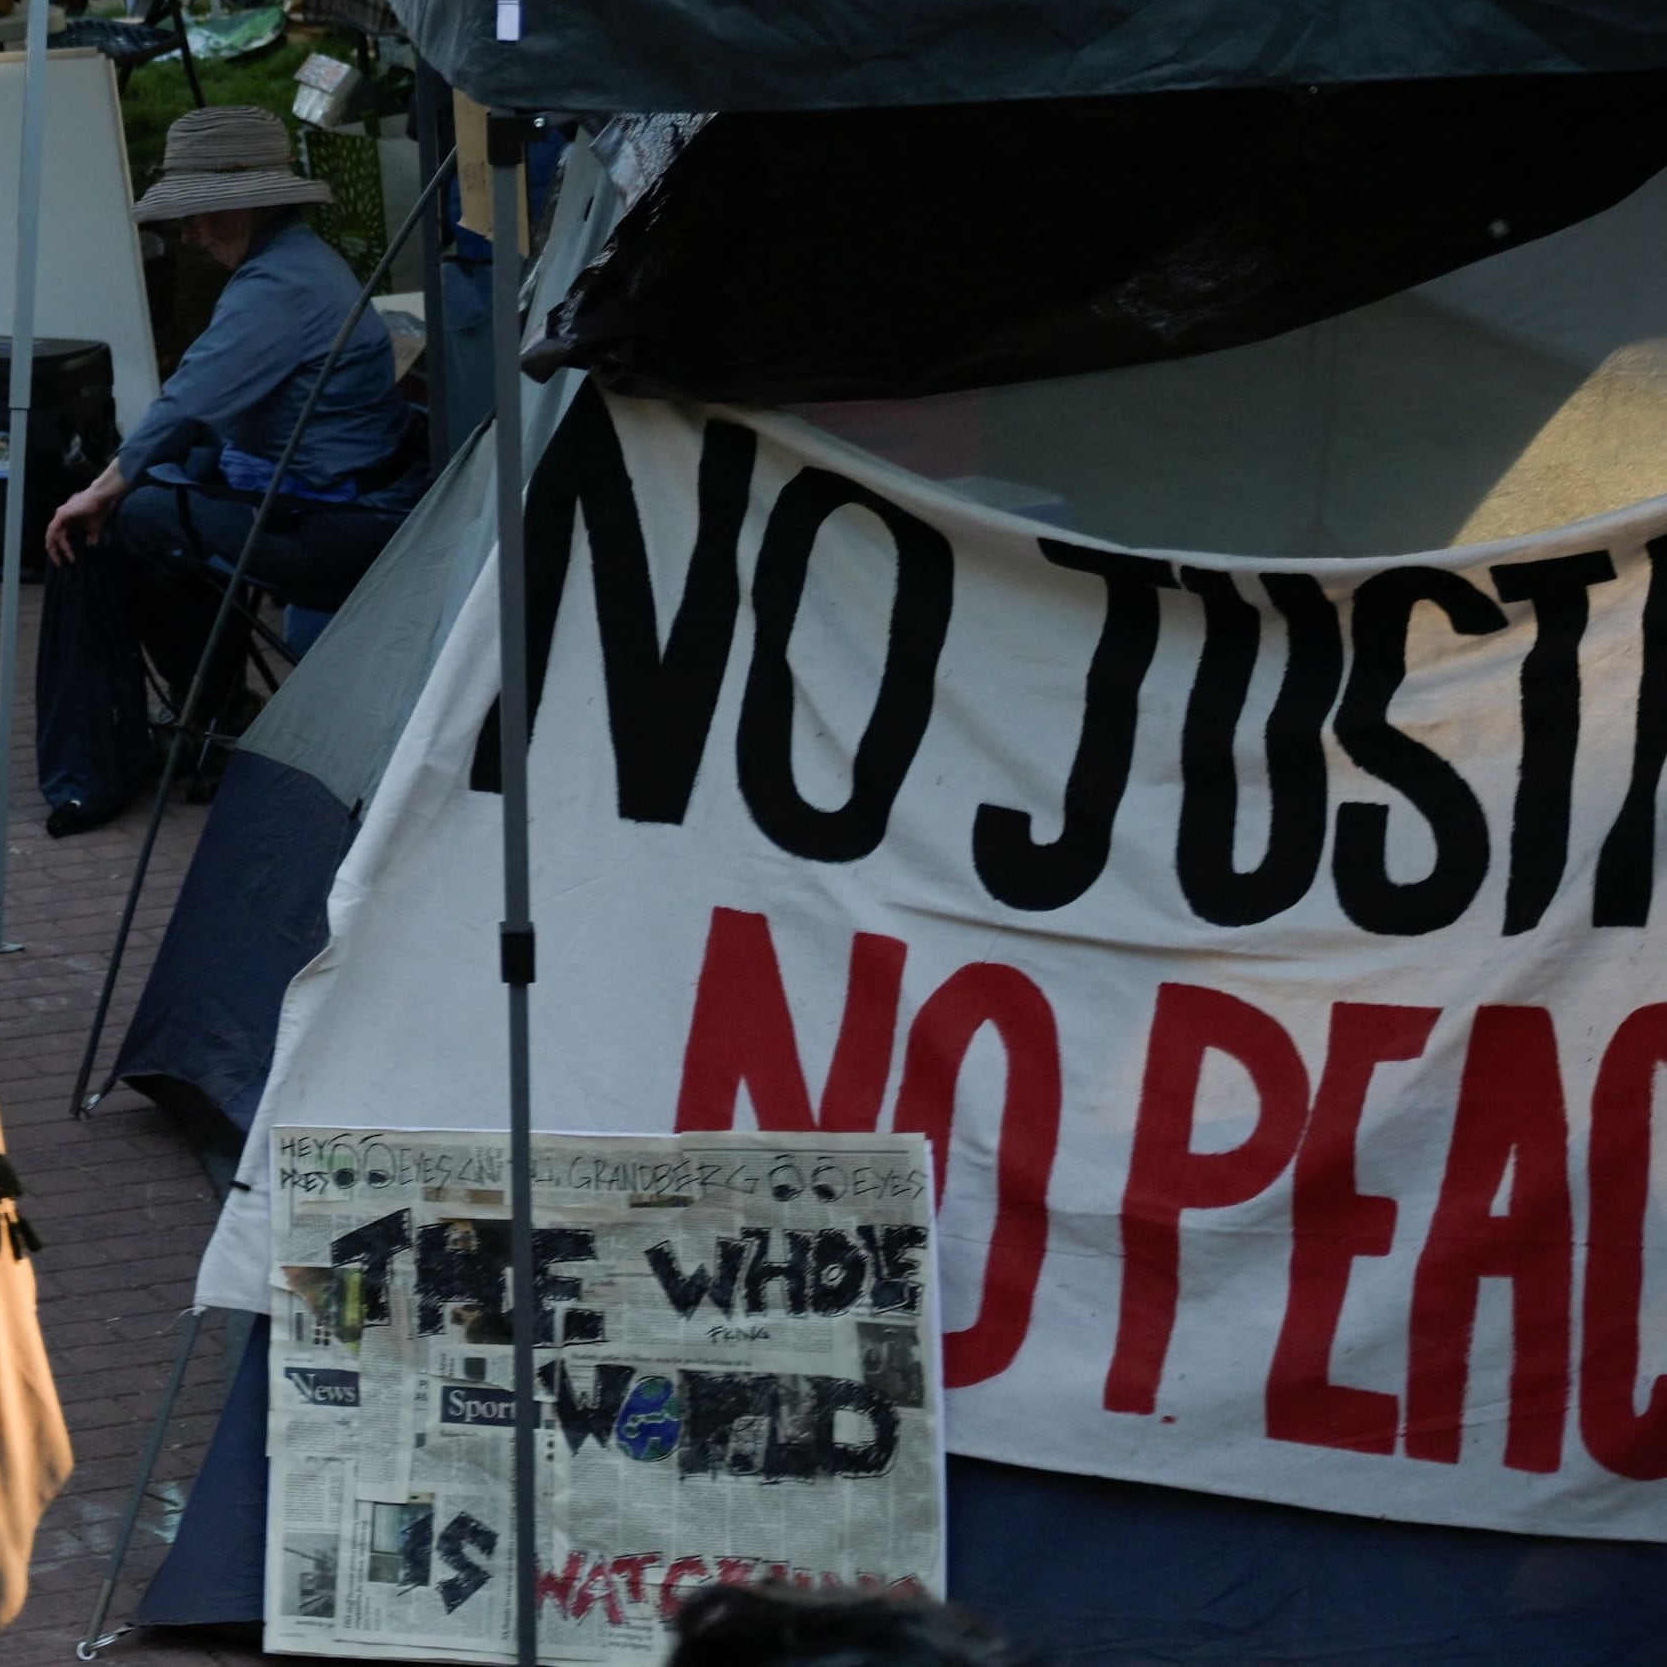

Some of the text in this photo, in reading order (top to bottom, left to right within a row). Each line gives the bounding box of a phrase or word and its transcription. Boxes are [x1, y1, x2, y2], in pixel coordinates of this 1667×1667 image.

[469, 373, 954, 864] NO
[280, 1136, 329, 1161] HEY
[400, 1147, 454, 1195] EYES
[853, 1166, 925, 1199] EYES
[674, 906, 1061, 1391] NO
[330, 1208, 928, 1347] THE WHOLE
[286, 1373, 357, 1405] News
[396, 1511, 499, 1614] IS
[535, 1550, 927, 1628] WATC
